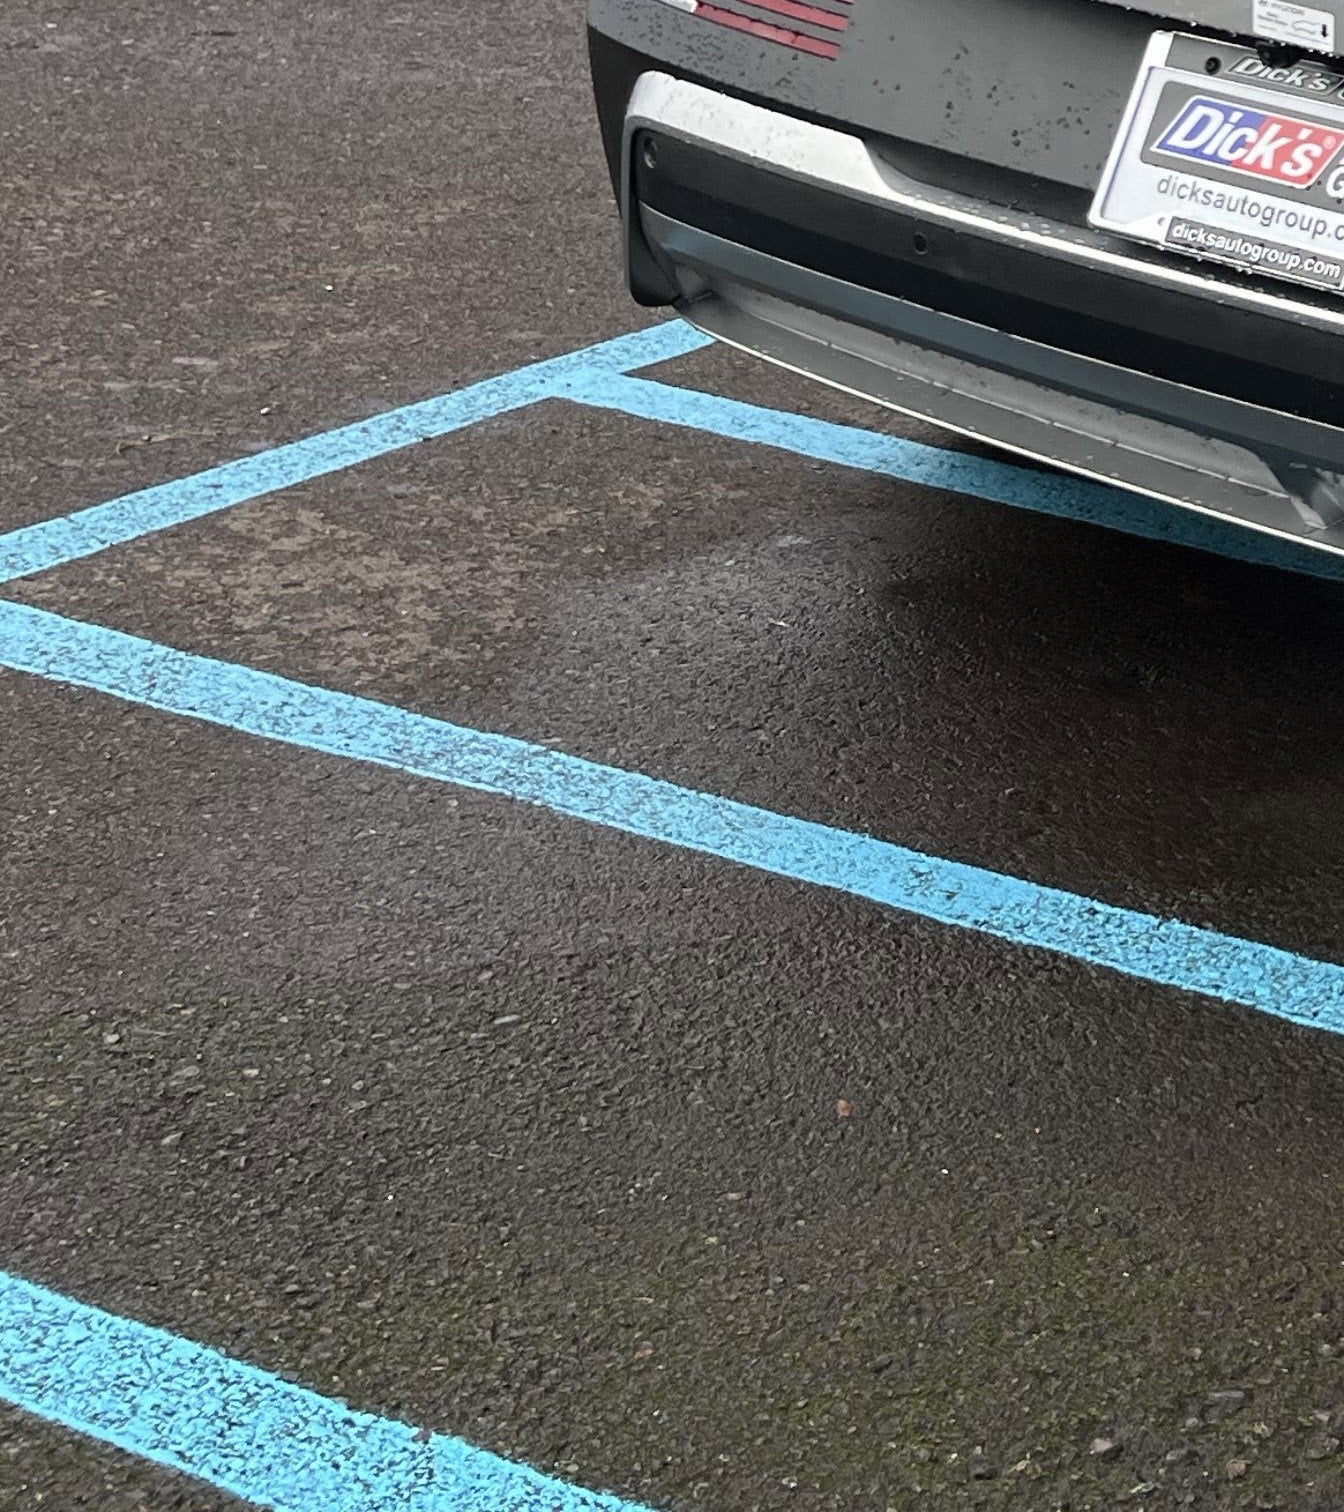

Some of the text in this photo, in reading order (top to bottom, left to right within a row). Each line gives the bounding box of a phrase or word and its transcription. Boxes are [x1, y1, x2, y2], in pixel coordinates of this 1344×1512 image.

[1234, 58, 1331, 91] Dick's
[1166, 104, 1323, 178] Dick's
[1172, 222, 1342, 279] dicksautogroup.com
